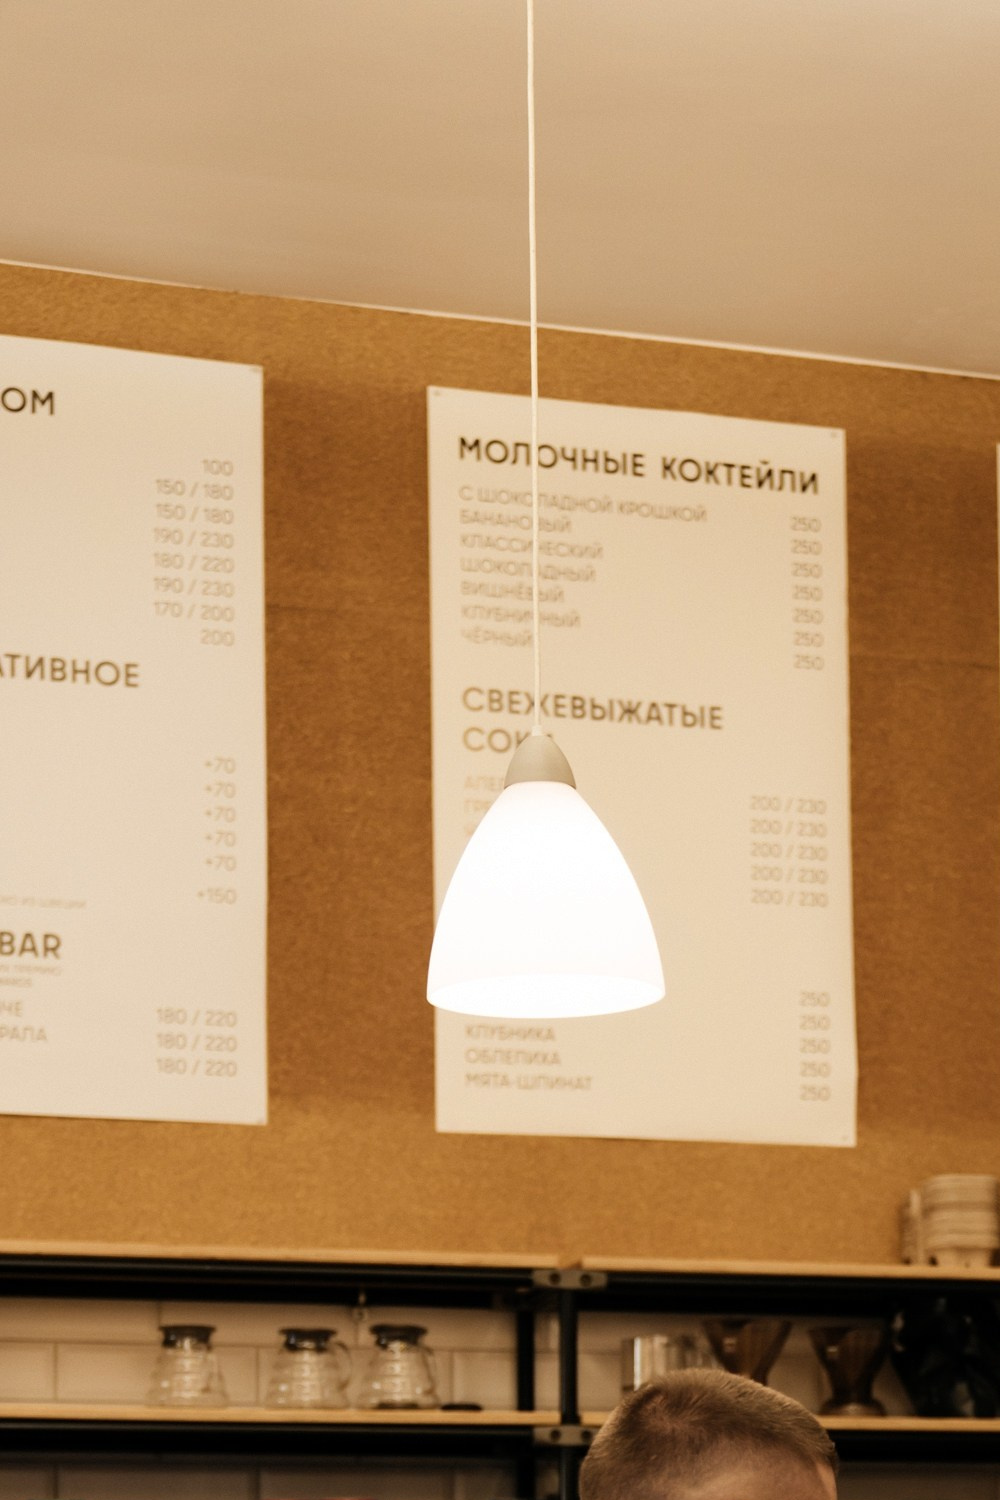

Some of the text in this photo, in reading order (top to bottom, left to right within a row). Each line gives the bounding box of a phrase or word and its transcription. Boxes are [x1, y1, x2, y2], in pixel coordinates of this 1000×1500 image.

[202, 459, 234, 476] 100
[459, 437, 819, 495] МОЛОЧНЫЕ КОКТЕЙЛИ
[156, 479, 234, 501] 150 180
[156, 503, 234, 525] 150 180
[154, 527, 234, 549] 190 230
[154, 552, 234, 574] 180 220
[154, 577, 235, 598] 190 230
[154, 601, 235, 622] 170 200
[461, 603, 581, 628] КЛУБНИНЫЙ
[201, 629, 235, 647] 200
[462, 687, 723, 730] СВЕЖЕВЫЖАТЫЕ
[462, 727, 553, 754] СОК
[204, 756, 236, 774] +70
[205, 781, 236, 799] +70
[750, 795, 781, 812] 200
[205, 806, 236, 823] +70
[750, 819, 781, 836] 200
[205, 831, 236, 848] +70
[750, 842, 782, 859] 200
[205, 855, 236, 872] +70
[751, 865, 782, 883] 200
[751, 889, 783, 906] 200
[0, 931, 61, 959] BAR
[156, 1007, 238, 1028] 180 220
[156, 1032, 238, 1052] 180 220
[156, 1058, 238, 1078] 180 220
